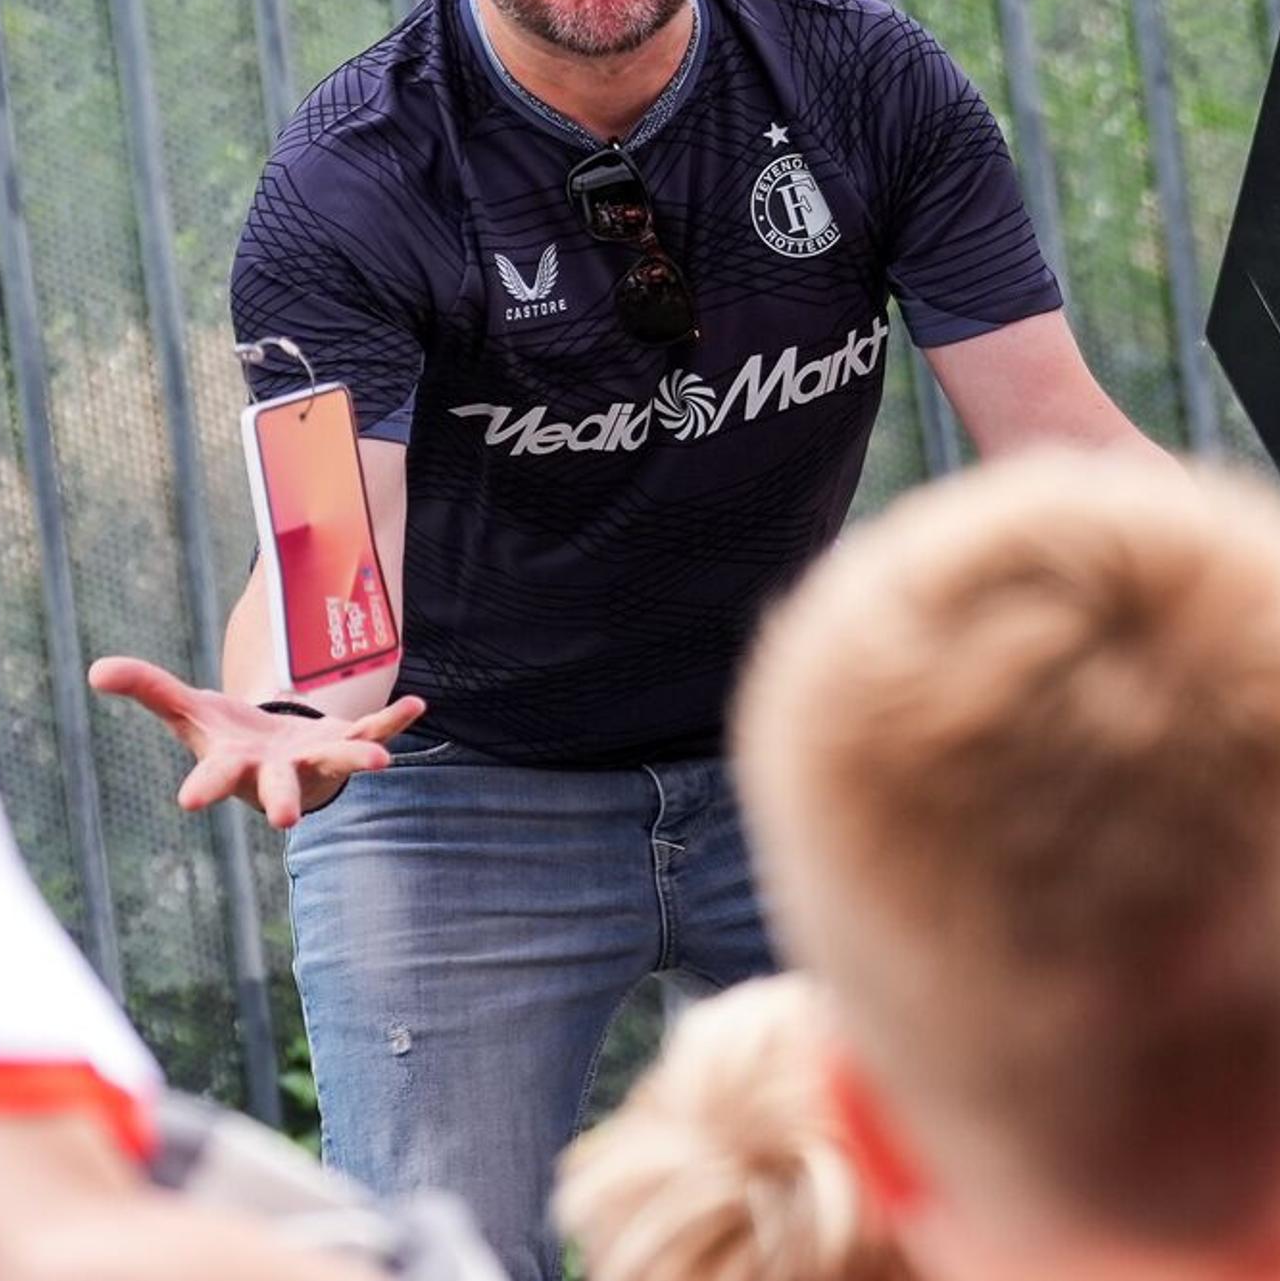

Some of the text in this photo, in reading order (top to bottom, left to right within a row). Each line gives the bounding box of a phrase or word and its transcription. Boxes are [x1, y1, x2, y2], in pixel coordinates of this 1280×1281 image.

[756, 158, 808, 202] FEYENO
[765, 223, 839, 253] ROTTERD
[505, 299, 568, 321] CASTORE
